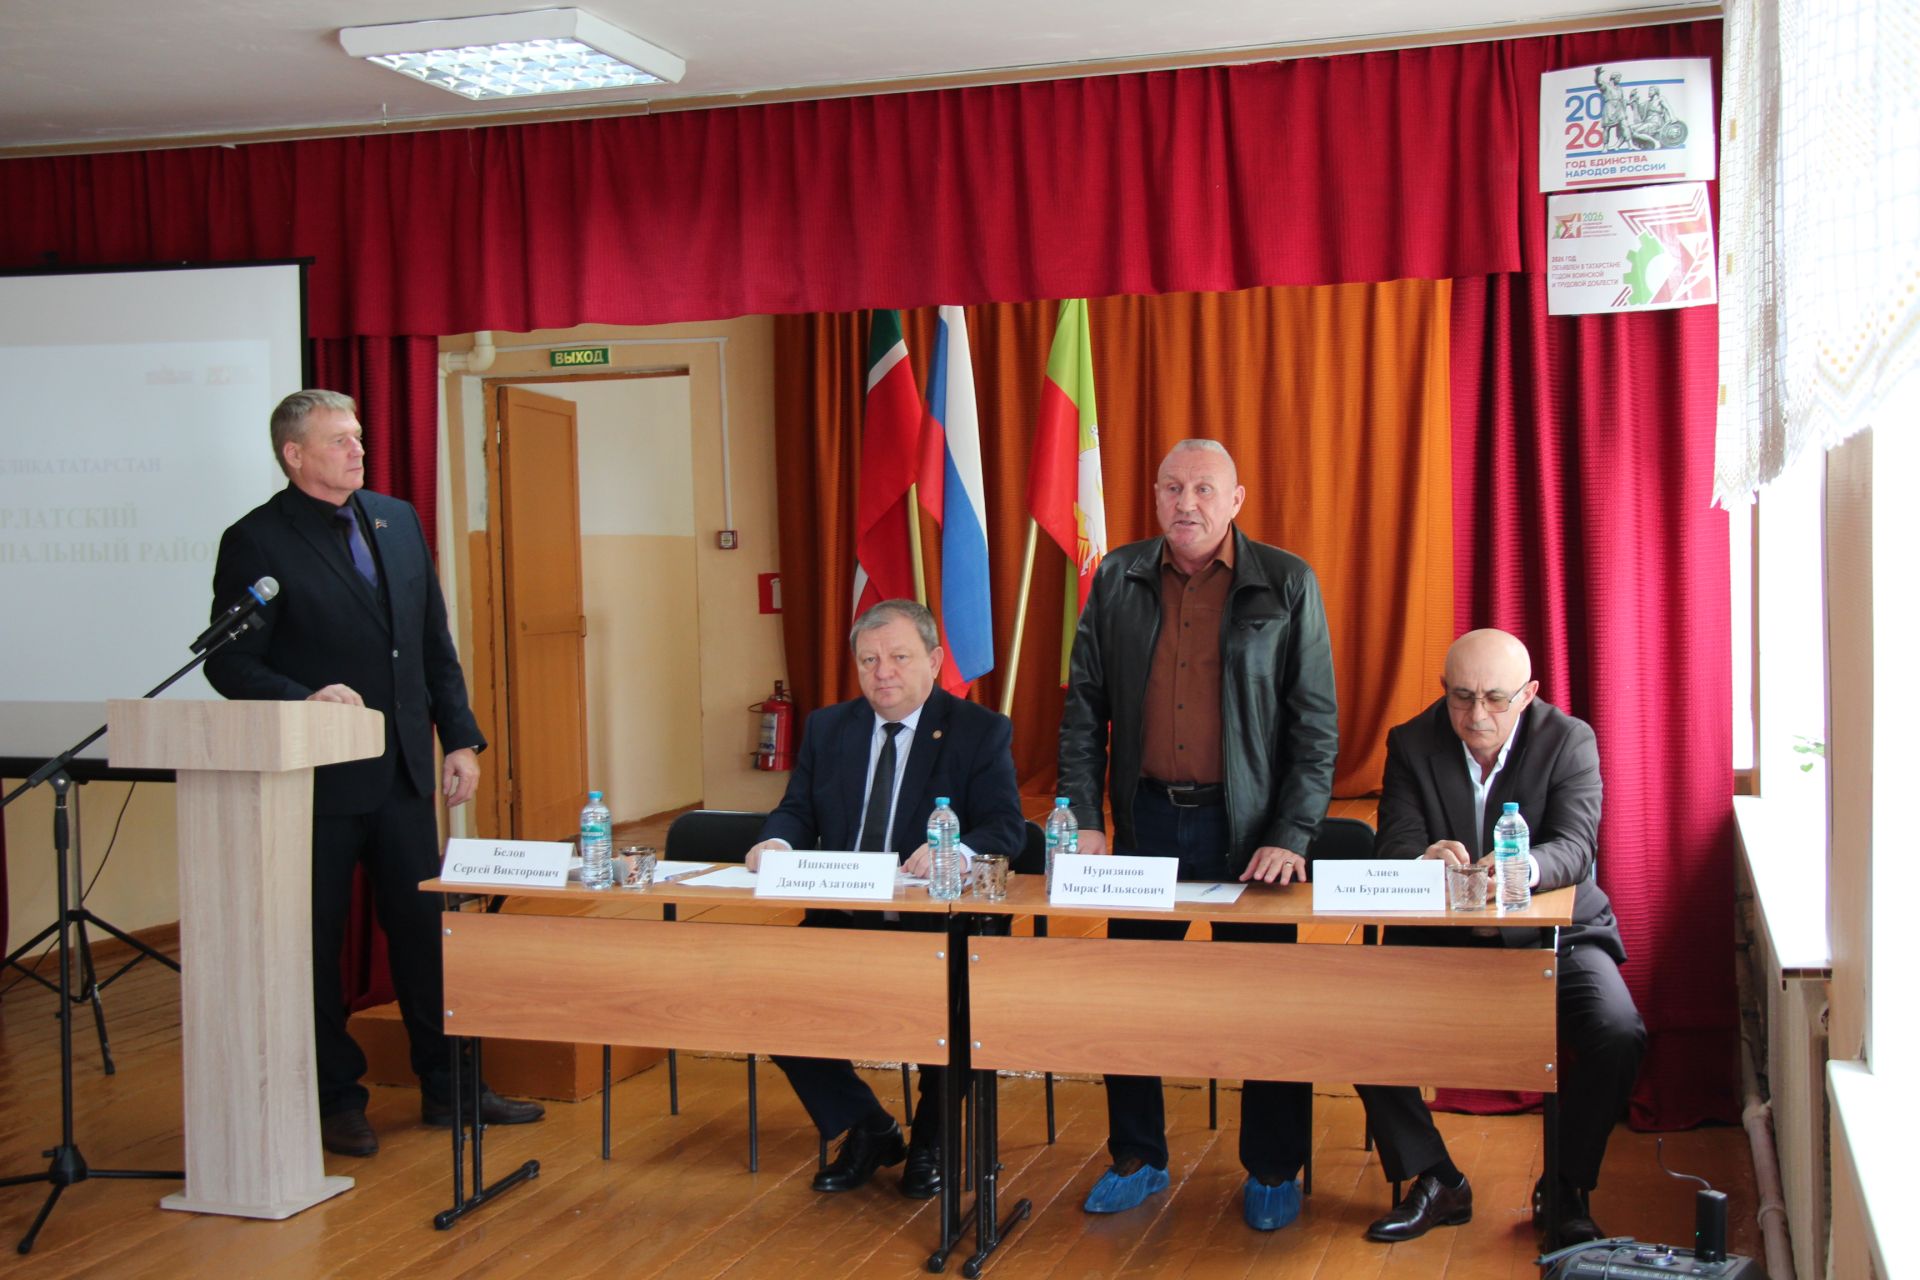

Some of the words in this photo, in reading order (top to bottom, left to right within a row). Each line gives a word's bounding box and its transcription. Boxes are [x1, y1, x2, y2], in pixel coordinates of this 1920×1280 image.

[1565, 92, 1604, 122] 20
[1565, 121, 1604, 150] 26
[1565, 160, 1586, 169] ГОД
[1590, 155, 1648, 167] ЕДИНСТВА
[1565, 166, 1617, 178] НАРОДОВ
[1620, 163, 1666, 176] РОССИИ
[555, 350, 604, 365] ВЫХОД
[56, 457, 161, 473] ТАТАРСТАН
[493, 847, 526, 858] Белов
[453, 863, 490, 876] Сергей
[493, 865, 560, 879] Викторович
[797, 859, 860, 870] Ишкинеев
[1083, 865, 1145, 877] Нуризянов
[1366, 869, 1399, 877] Алиев
[776, 877, 816, 890] Дамир
[818, 879, 875, 889] Азатович
[1062, 883, 1099, 895] Мирас
[1102, 884, 1165, 895] Ильясович
[1334, 884, 1356, 893] Али
[1359, 885, 1431, 895] Бураганович
